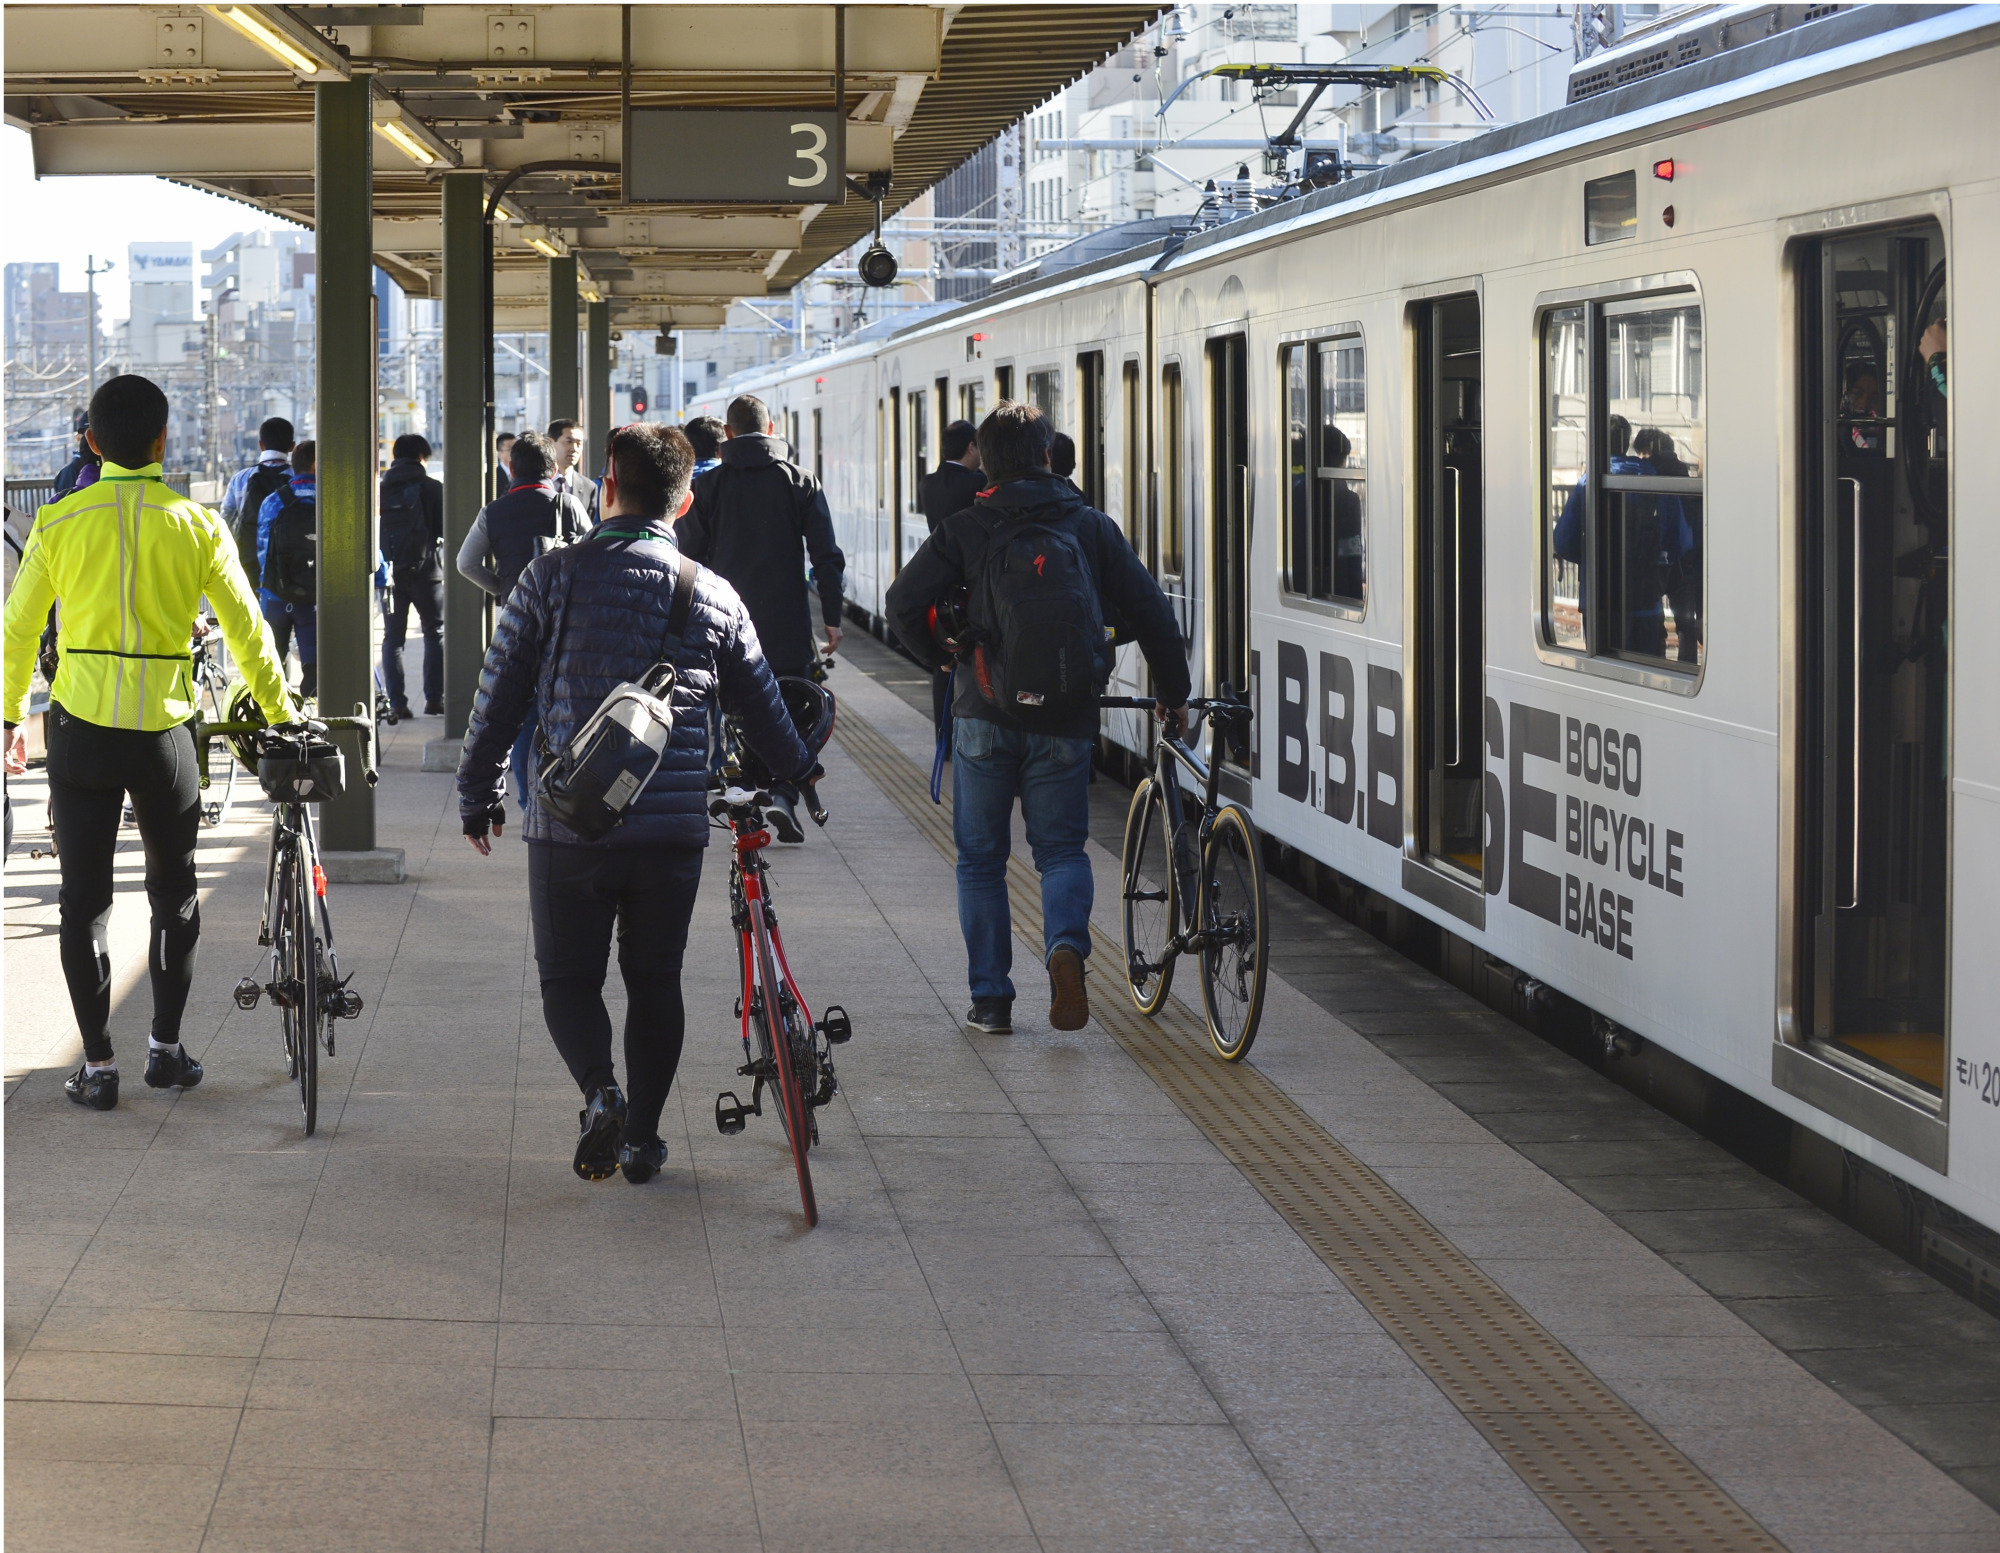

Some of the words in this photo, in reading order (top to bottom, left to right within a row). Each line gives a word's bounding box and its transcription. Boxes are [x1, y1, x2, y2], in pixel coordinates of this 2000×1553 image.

[787, 122, 828, 188] 3
[1566, 715, 1642, 798] BOSO
[1566, 793, 1684, 898] BICYCLE
[1565, 872, 1634, 961] BASE
[1956, 1056, 1979, 1090] モハ
